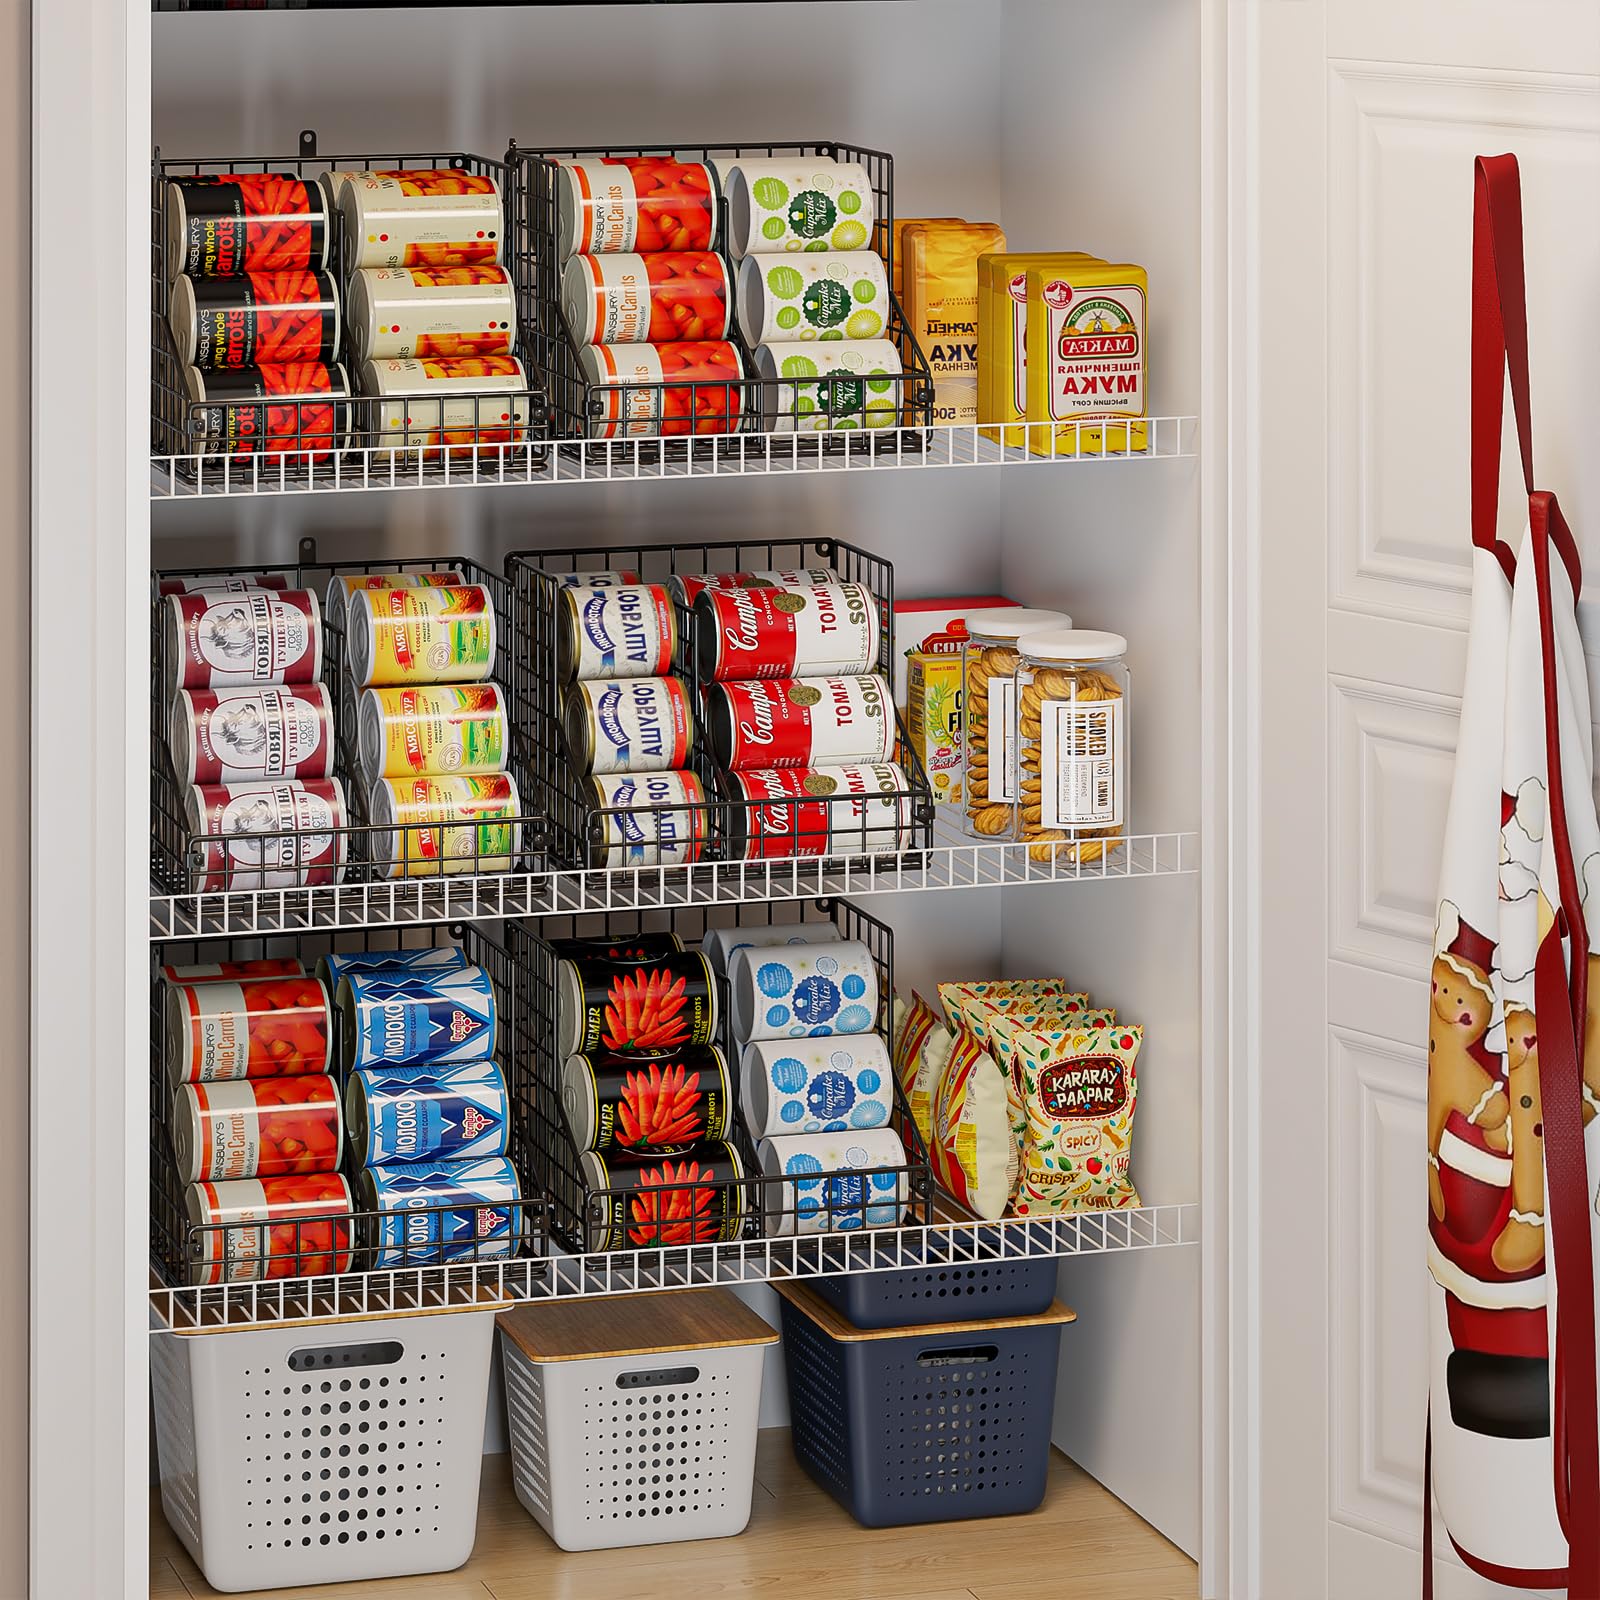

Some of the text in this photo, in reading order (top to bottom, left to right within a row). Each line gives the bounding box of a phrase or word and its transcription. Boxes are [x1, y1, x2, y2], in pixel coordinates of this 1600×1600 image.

[802, 193, 814, 238] Cupcake
[814, 197, 828, 226] Mix
[215, 216, 235, 272] arrots
[602, 223, 624, 253] Whole
[816, 282, 829, 327] Cupcake
[829, 287, 842, 315] Mix
[214, 312, 225, 346] whole
[225, 309, 245, 363] arrots
[616, 313, 637, 342] Whole
[633, 365, 651, 403] Caots
[808, 583, 837, 634] TOMAT
[839, 584, 867, 625] SOUP
[252, 596, 270, 676] ГОВЯДИНА
[274, 606, 287, 664] ТУШЕНАЯ
[287, 625, 296, 649] ГОСТ
[392, 597, 407, 653] МЯСО КУР
[823, 676, 853, 727] TOMAT
[855, 675, 882, 718] SOUP
[266, 691, 281, 772] ГОВЯДИНА
[286, 701, 298, 760] ТУШЕНАЯ
[299, 719, 308, 745] ГОСТ
[403, 697, 418, 754] МЯСО КУР
[1088, 711, 1107, 756] SMOKED
[1097, 761, 1110, 775] 03
[416, 787, 427, 805] КУР
[934, 791, 943, 800] kg
[1097, 781, 1109, 807] ALMOND
[279, 787, 294, 867] ГОВДИНА
[298, 797, 310, 857] ТУЕНАЯ
[693, 996, 702, 1029] CARROTS
[807, 979, 819, 1023] Cupcake
[820, 983, 832, 1011] Mix
[383, 1004, 405, 1057] МОЛОКО
[203, 1023, 215, 1080] SAINSBURY'S
[214, 1051, 233, 1080] Whole
[821, 1074, 834, 1118] Cupcake
[834, 1078, 846, 1107] Mix
[1052, 1067, 1118, 1092] KARARAY
[1056, 1086, 1114, 1109] PAAPAR
[395, 1100, 417, 1154] МОЛОКО
[707, 1092, 716, 1125] CARROTS
[213, 1121, 225, 1179] SAINSBURY'S
[1066, 1134, 1099, 1151] SPICY
[225, 1150, 246, 1178] Whole
[1028, 1171, 1080, 1186] CRISPY
[235, 1251, 256, 1278] Whoe
